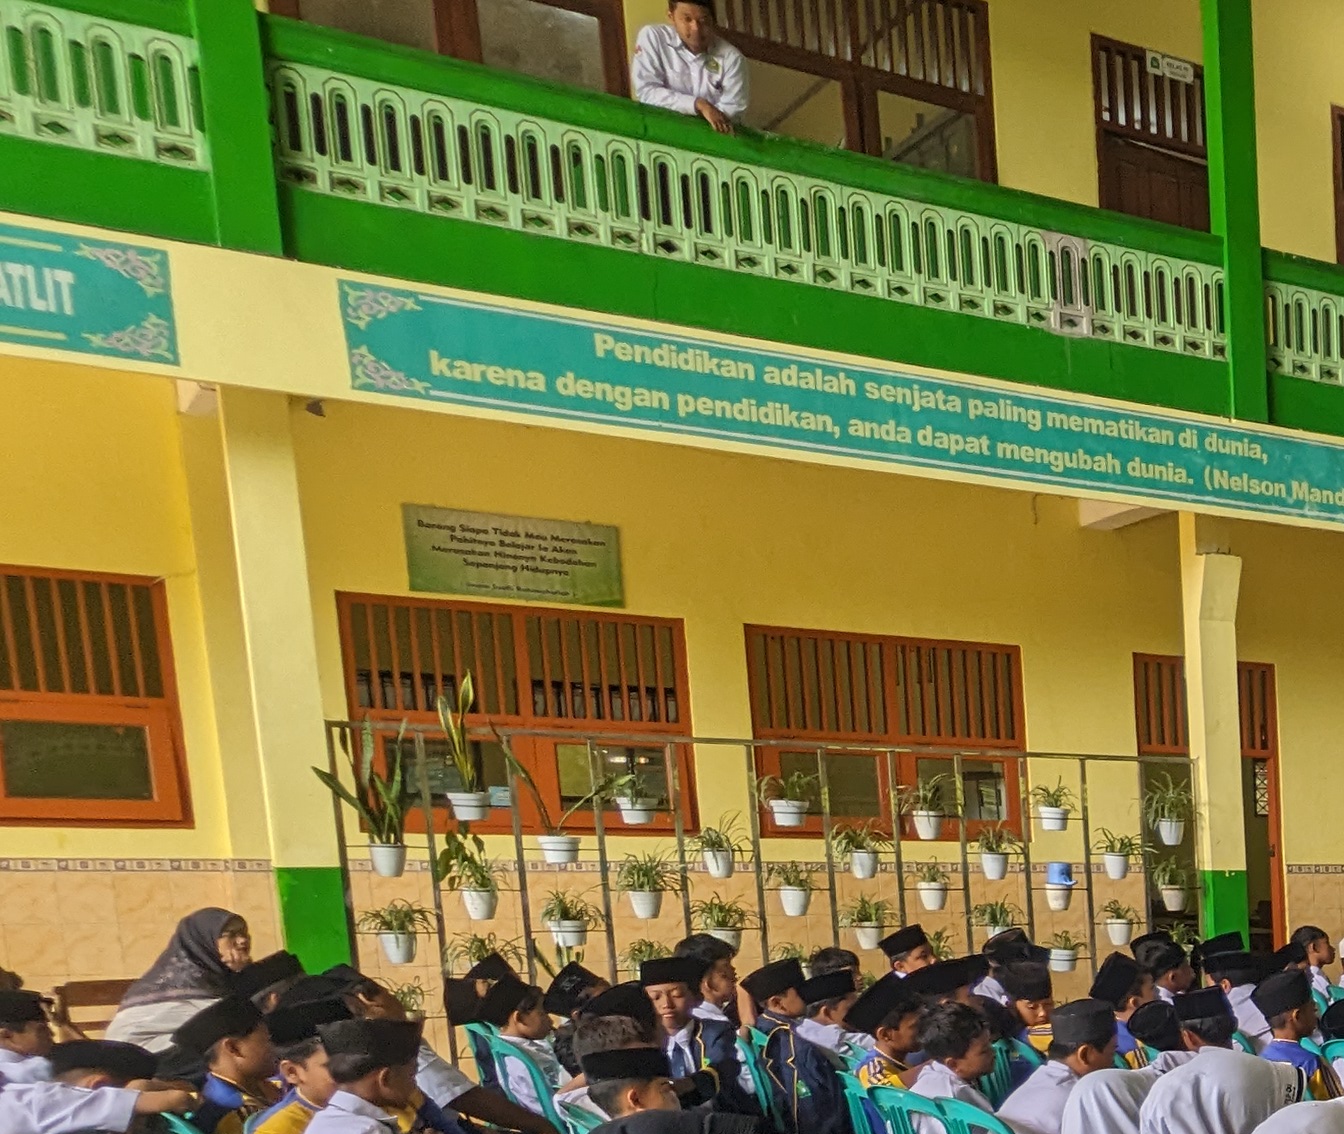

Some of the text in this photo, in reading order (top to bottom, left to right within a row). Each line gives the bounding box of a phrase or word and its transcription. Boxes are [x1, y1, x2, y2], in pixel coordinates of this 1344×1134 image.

[429, 350, 546, 392] karena
[556, 372, 670, 412] dengan
[677, 392, 840, 438] pendidikan,
[848, 418, 912, 444] anda
[917, 425, 990, 456] dapat
[996, 441, 1120, 475] mengubah
[1127, 456, 1195, 486] dunia.
[1204, 464, 1286, 499] (Nelson
[593, 332, 1269, 464] Pendidikan adalah senjata paling mematikan di dunia,
